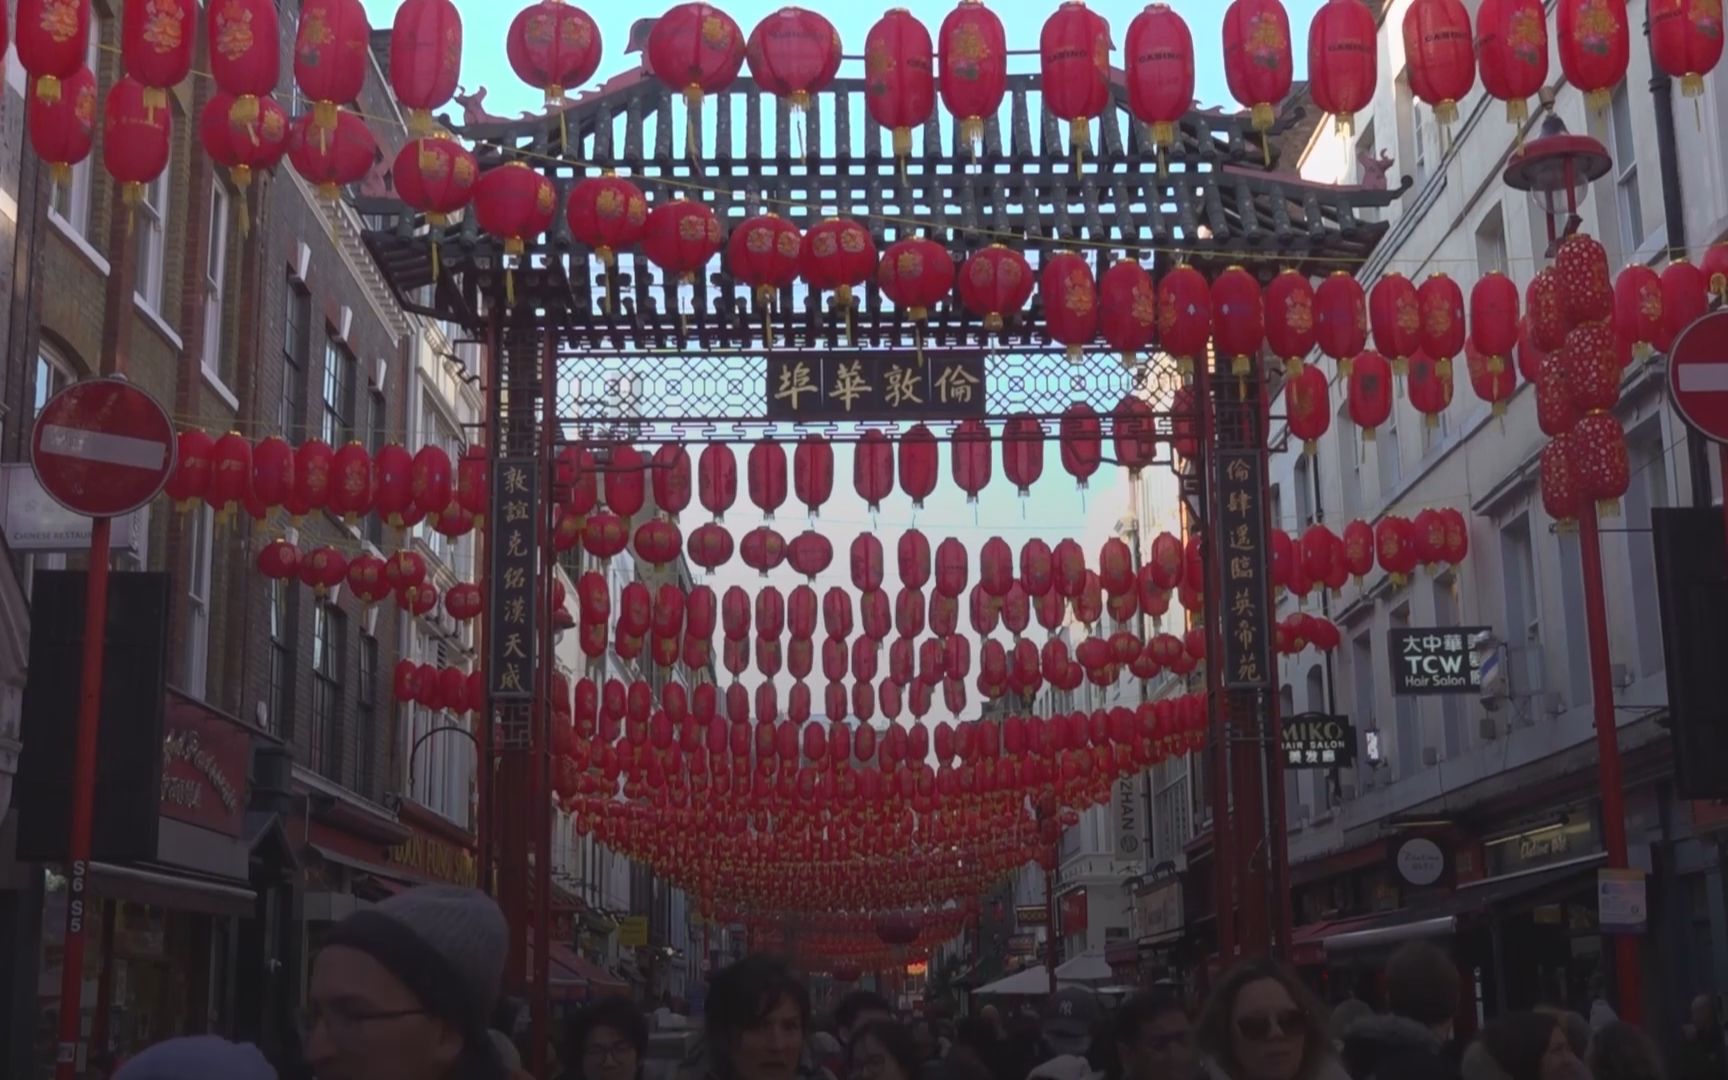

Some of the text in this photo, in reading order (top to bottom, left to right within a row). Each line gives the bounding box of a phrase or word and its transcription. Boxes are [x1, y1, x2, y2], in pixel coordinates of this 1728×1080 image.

[1403, 634, 1463, 653] 大中華
[1404, 655, 1463, 674] TCW
[1405, 674, 1466, 687] Hair Salon
[1282, 721, 1344, 741] MIKO
[1309, 740, 1345, 750] SALON
